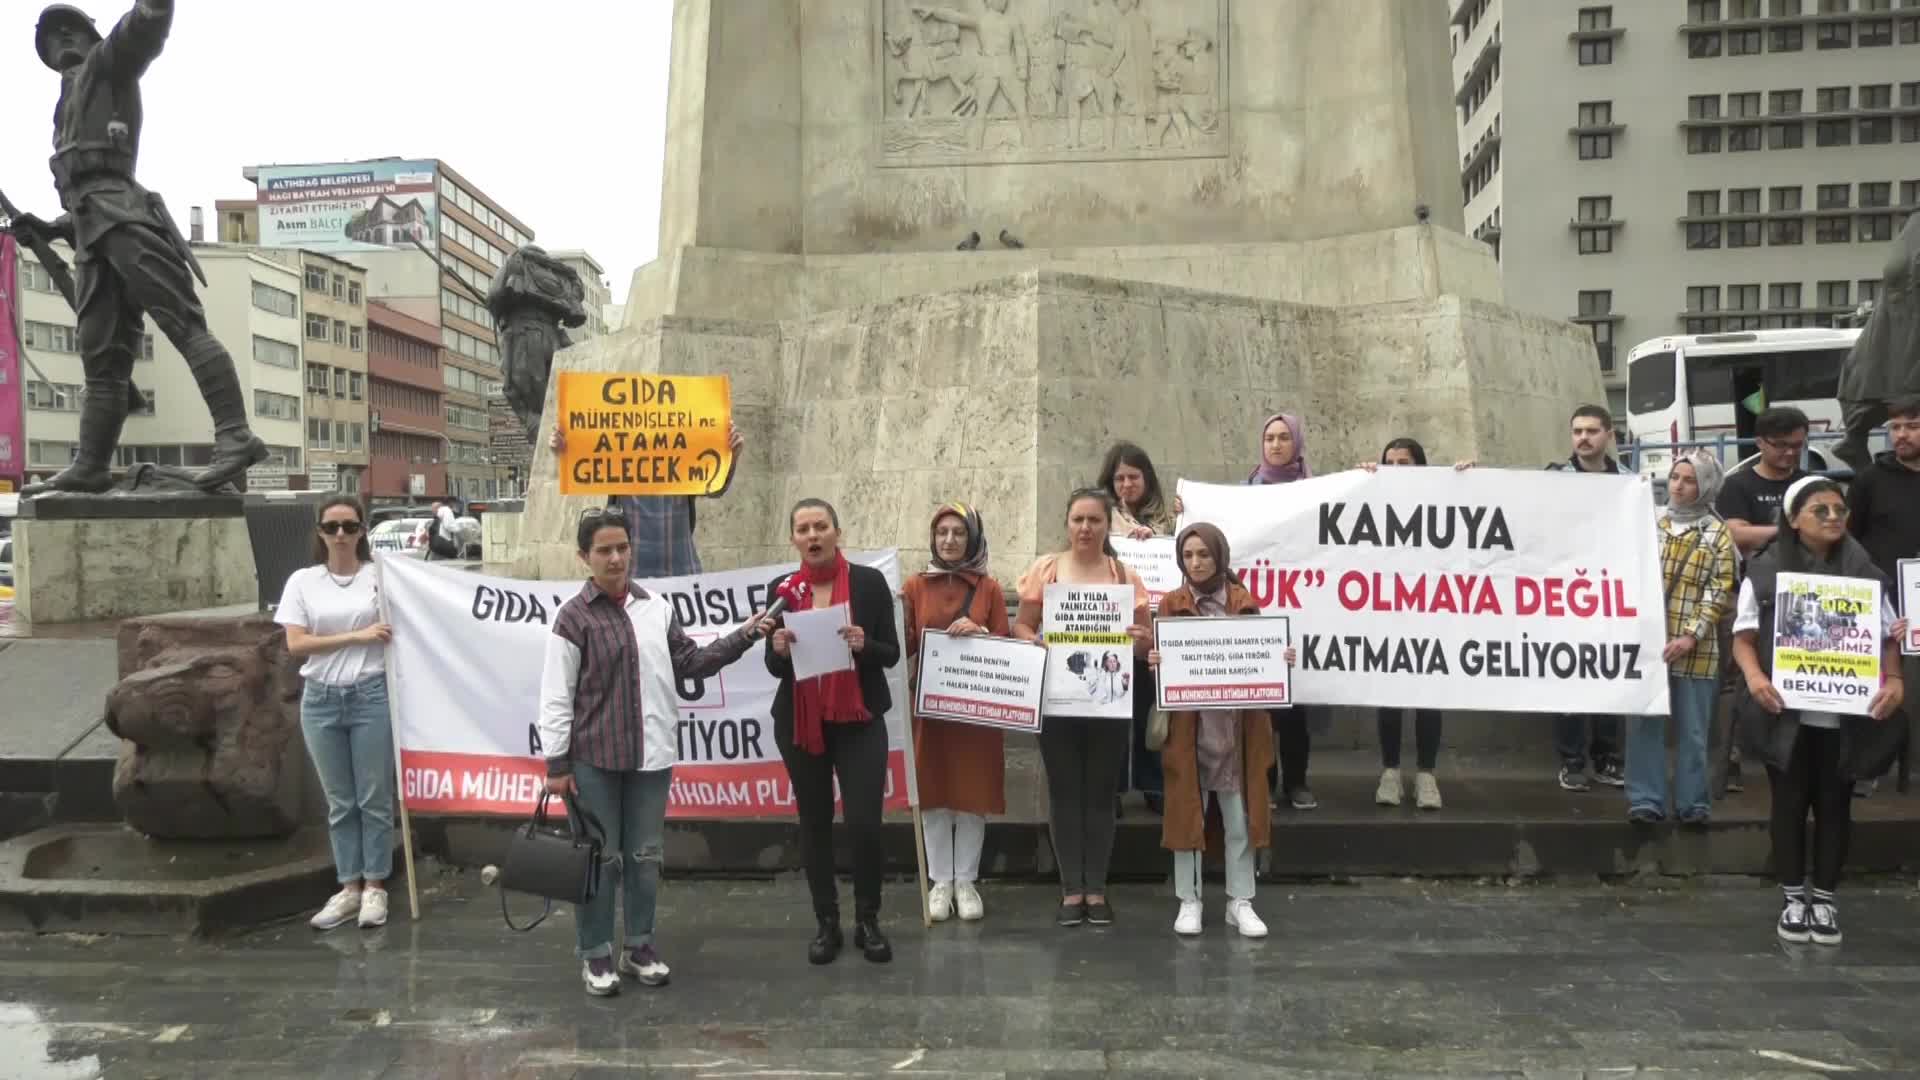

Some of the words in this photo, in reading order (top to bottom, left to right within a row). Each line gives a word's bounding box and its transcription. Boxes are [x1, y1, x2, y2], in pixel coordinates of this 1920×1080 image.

[602, 378, 676, 405] GIDA
[570, 408, 693, 430] MÜHENDİSLERİ
[594, 432, 688, 453] ATAMA
[573, 456, 682, 484] GELECEK
[1317, 502, 1514, 551] KAMUYA
[1068, 592, 1080, 601] İKİ
[1084, 592, 1108, 601] YILDA
[1337, 570, 1503, 616] OLMAYA
[1515, 568, 1637, 618] DEĞİL
[471, 584, 548, 625] GIDA
[1060, 602, 1098, 611] YALNIZCA
[1055, 612, 1074, 621] GIDA
[1077, 611, 1121, 622] MÜHENDİSİ
[1065, 623, 1111, 633] ATANDIĞINI
[1302, 634, 1449, 676] KATMAYA
[1459, 632, 1643, 680] GELİYORUZ
[1795, 664, 1857, 679] ATAMA
[1783, 679, 1869, 697] BEKLİYOR
[405, 769, 454, 801] GIDA
